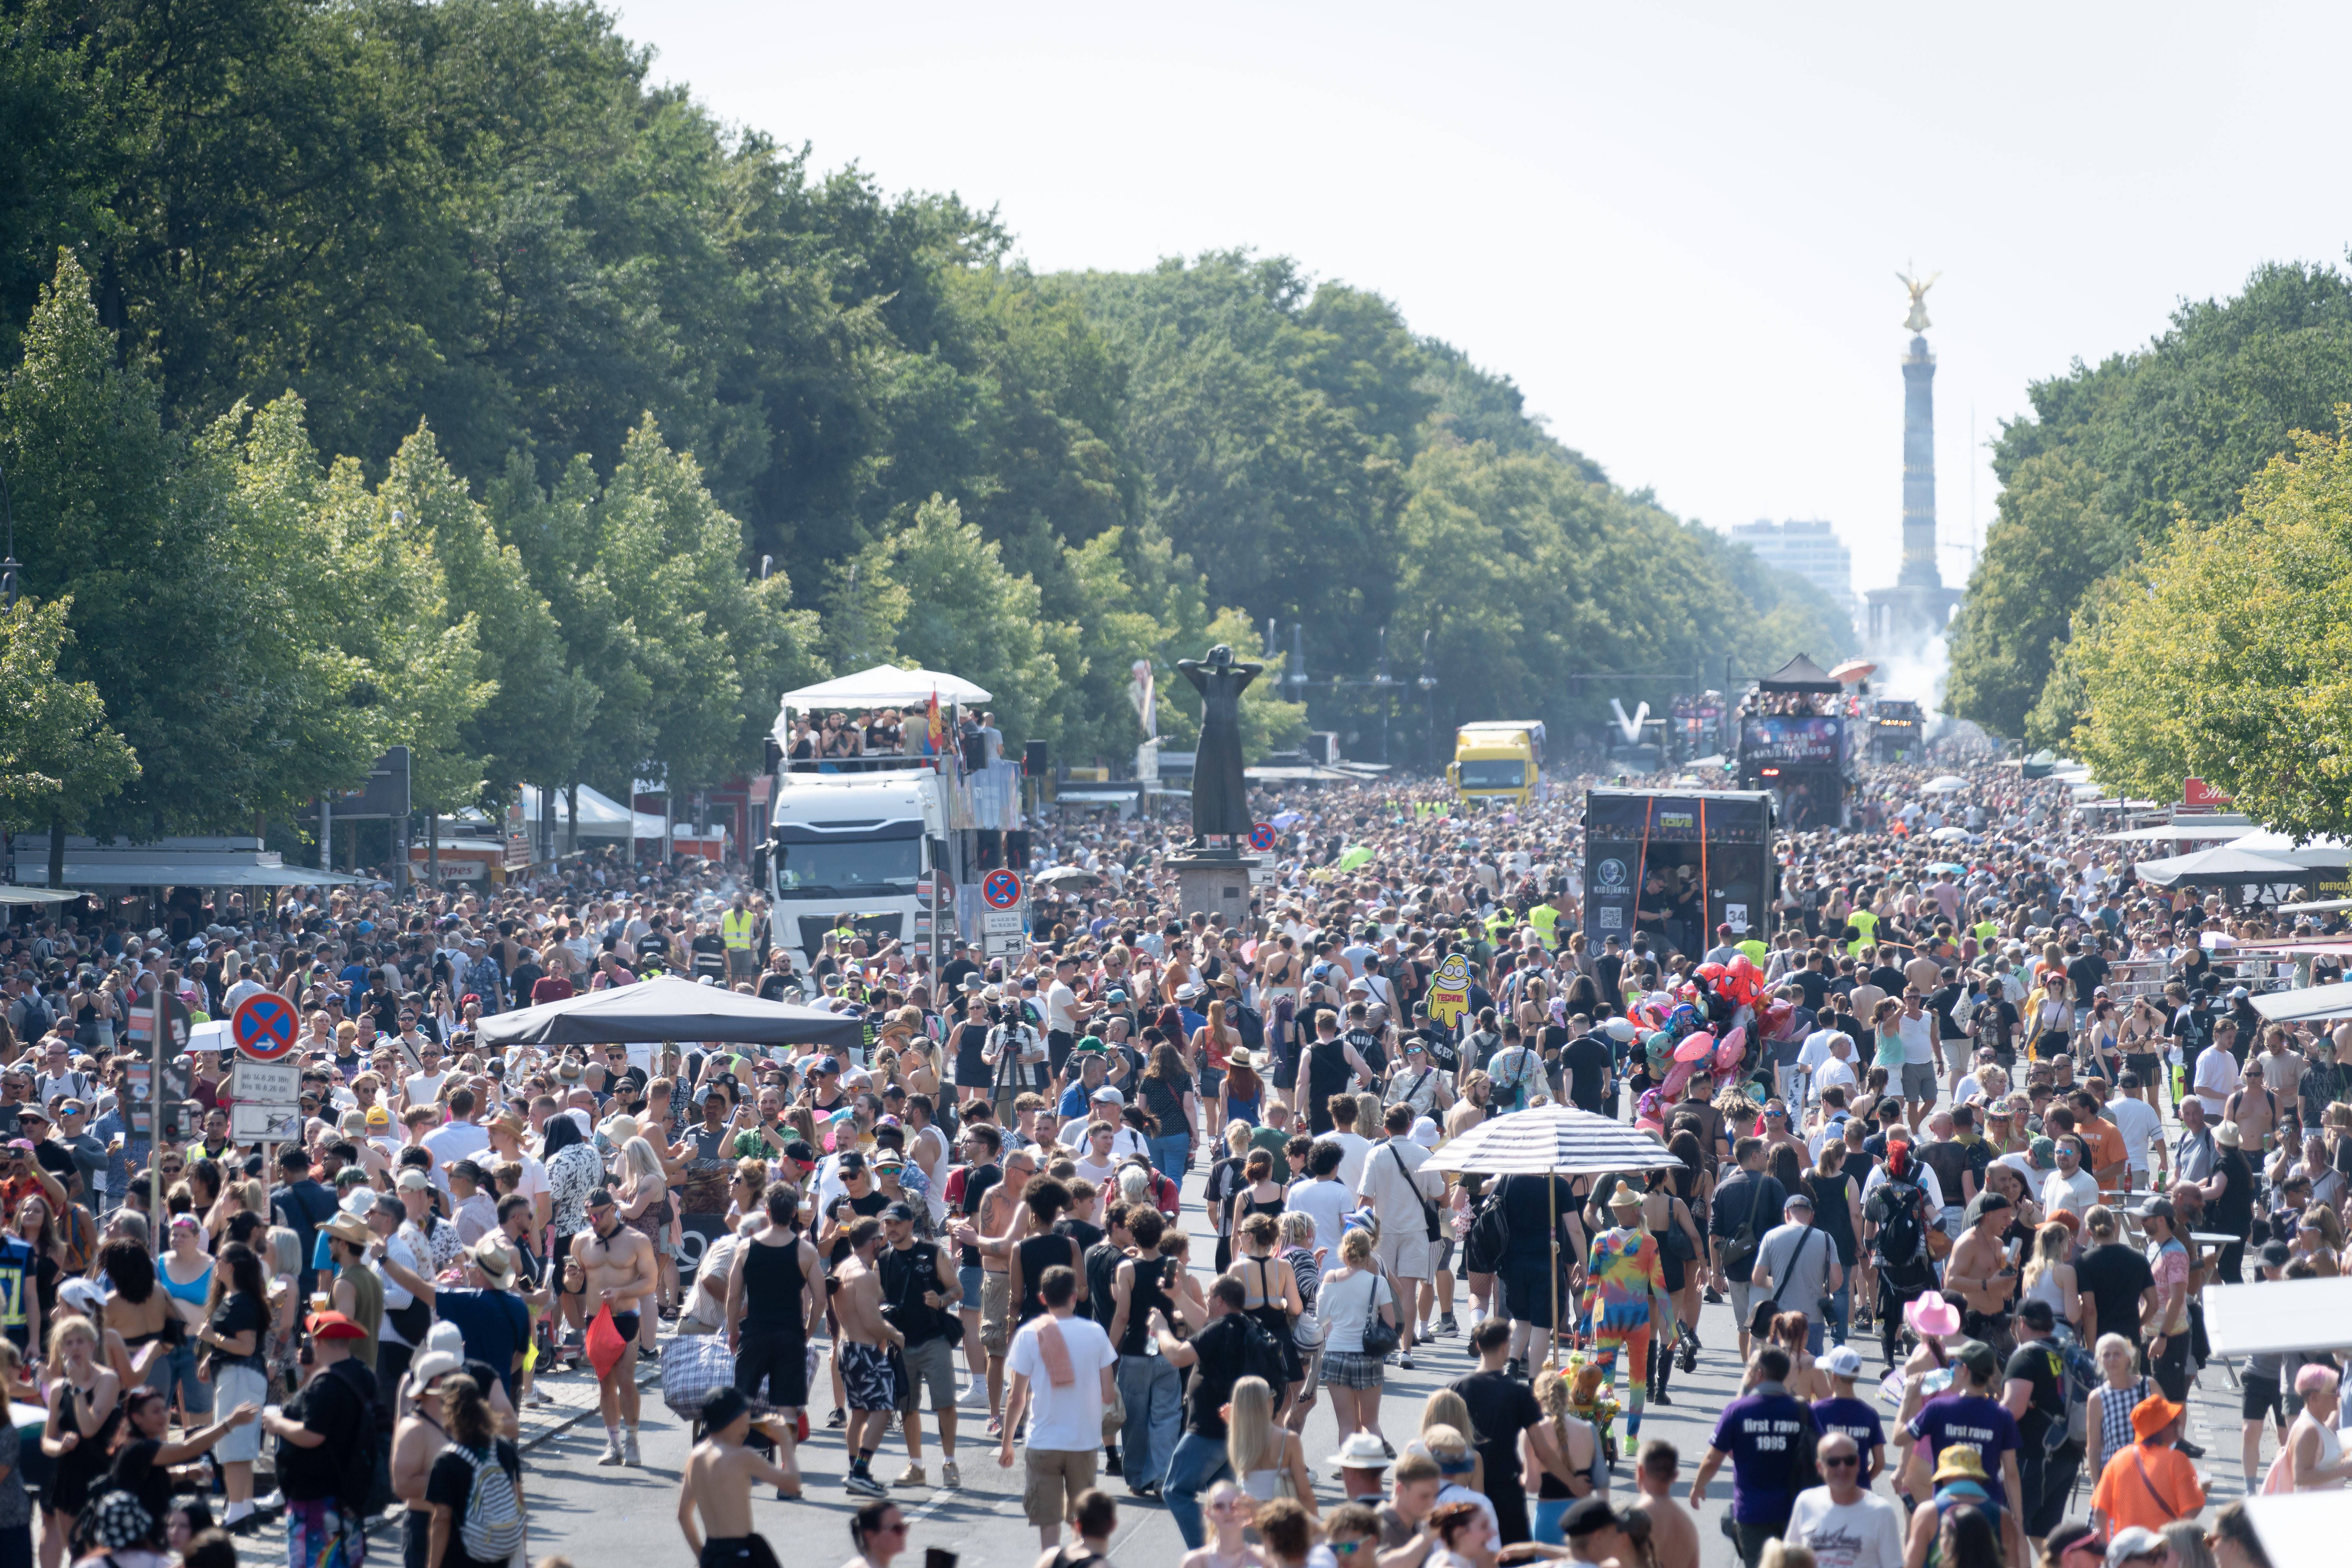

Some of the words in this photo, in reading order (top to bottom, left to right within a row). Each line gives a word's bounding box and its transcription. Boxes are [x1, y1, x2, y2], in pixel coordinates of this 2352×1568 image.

[423, 862, 473, 878] Cêpes
[2319, 882, 2352, 891] OFFICIA
[1729, 911, 1746, 922] 34
[1437, 993, 1463, 1002] TECHNO
[253, 1074, 276, 1082] 14.8.26
[255, 1083, 277, 1092] 16.8.26
[1743, 1418, 1769, 1433] first
[1774, 1420, 1800, 1434] rave
[1848, 1426, 1870, 1439] rave
[1945, 1424, 1967, 1437] first
[1969, 1427, 1994, 1441] rave
[1757, 1436, 1786, 1451] 1995
